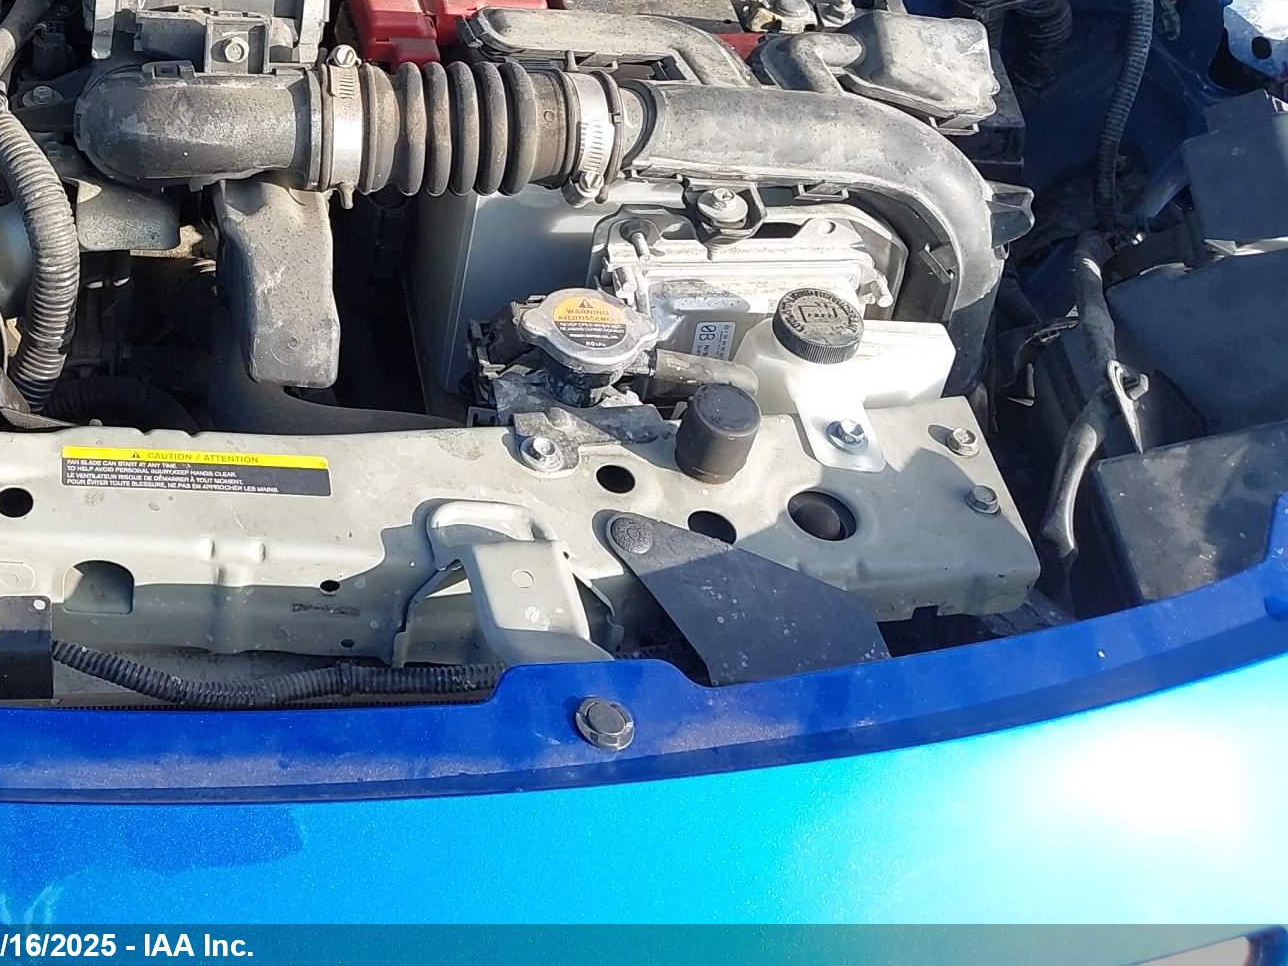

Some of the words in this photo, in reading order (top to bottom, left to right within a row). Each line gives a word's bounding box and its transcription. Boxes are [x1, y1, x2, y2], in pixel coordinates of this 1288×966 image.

[203, 454, 259, 463] ATTENTION
[87, 477, 109, 486] ÉVITER
[202, 484, 243, 492] APPROCHER
[154, 474, 189, 483] DÉMARRER
[214, 478, 244, 486] MOMENT.
